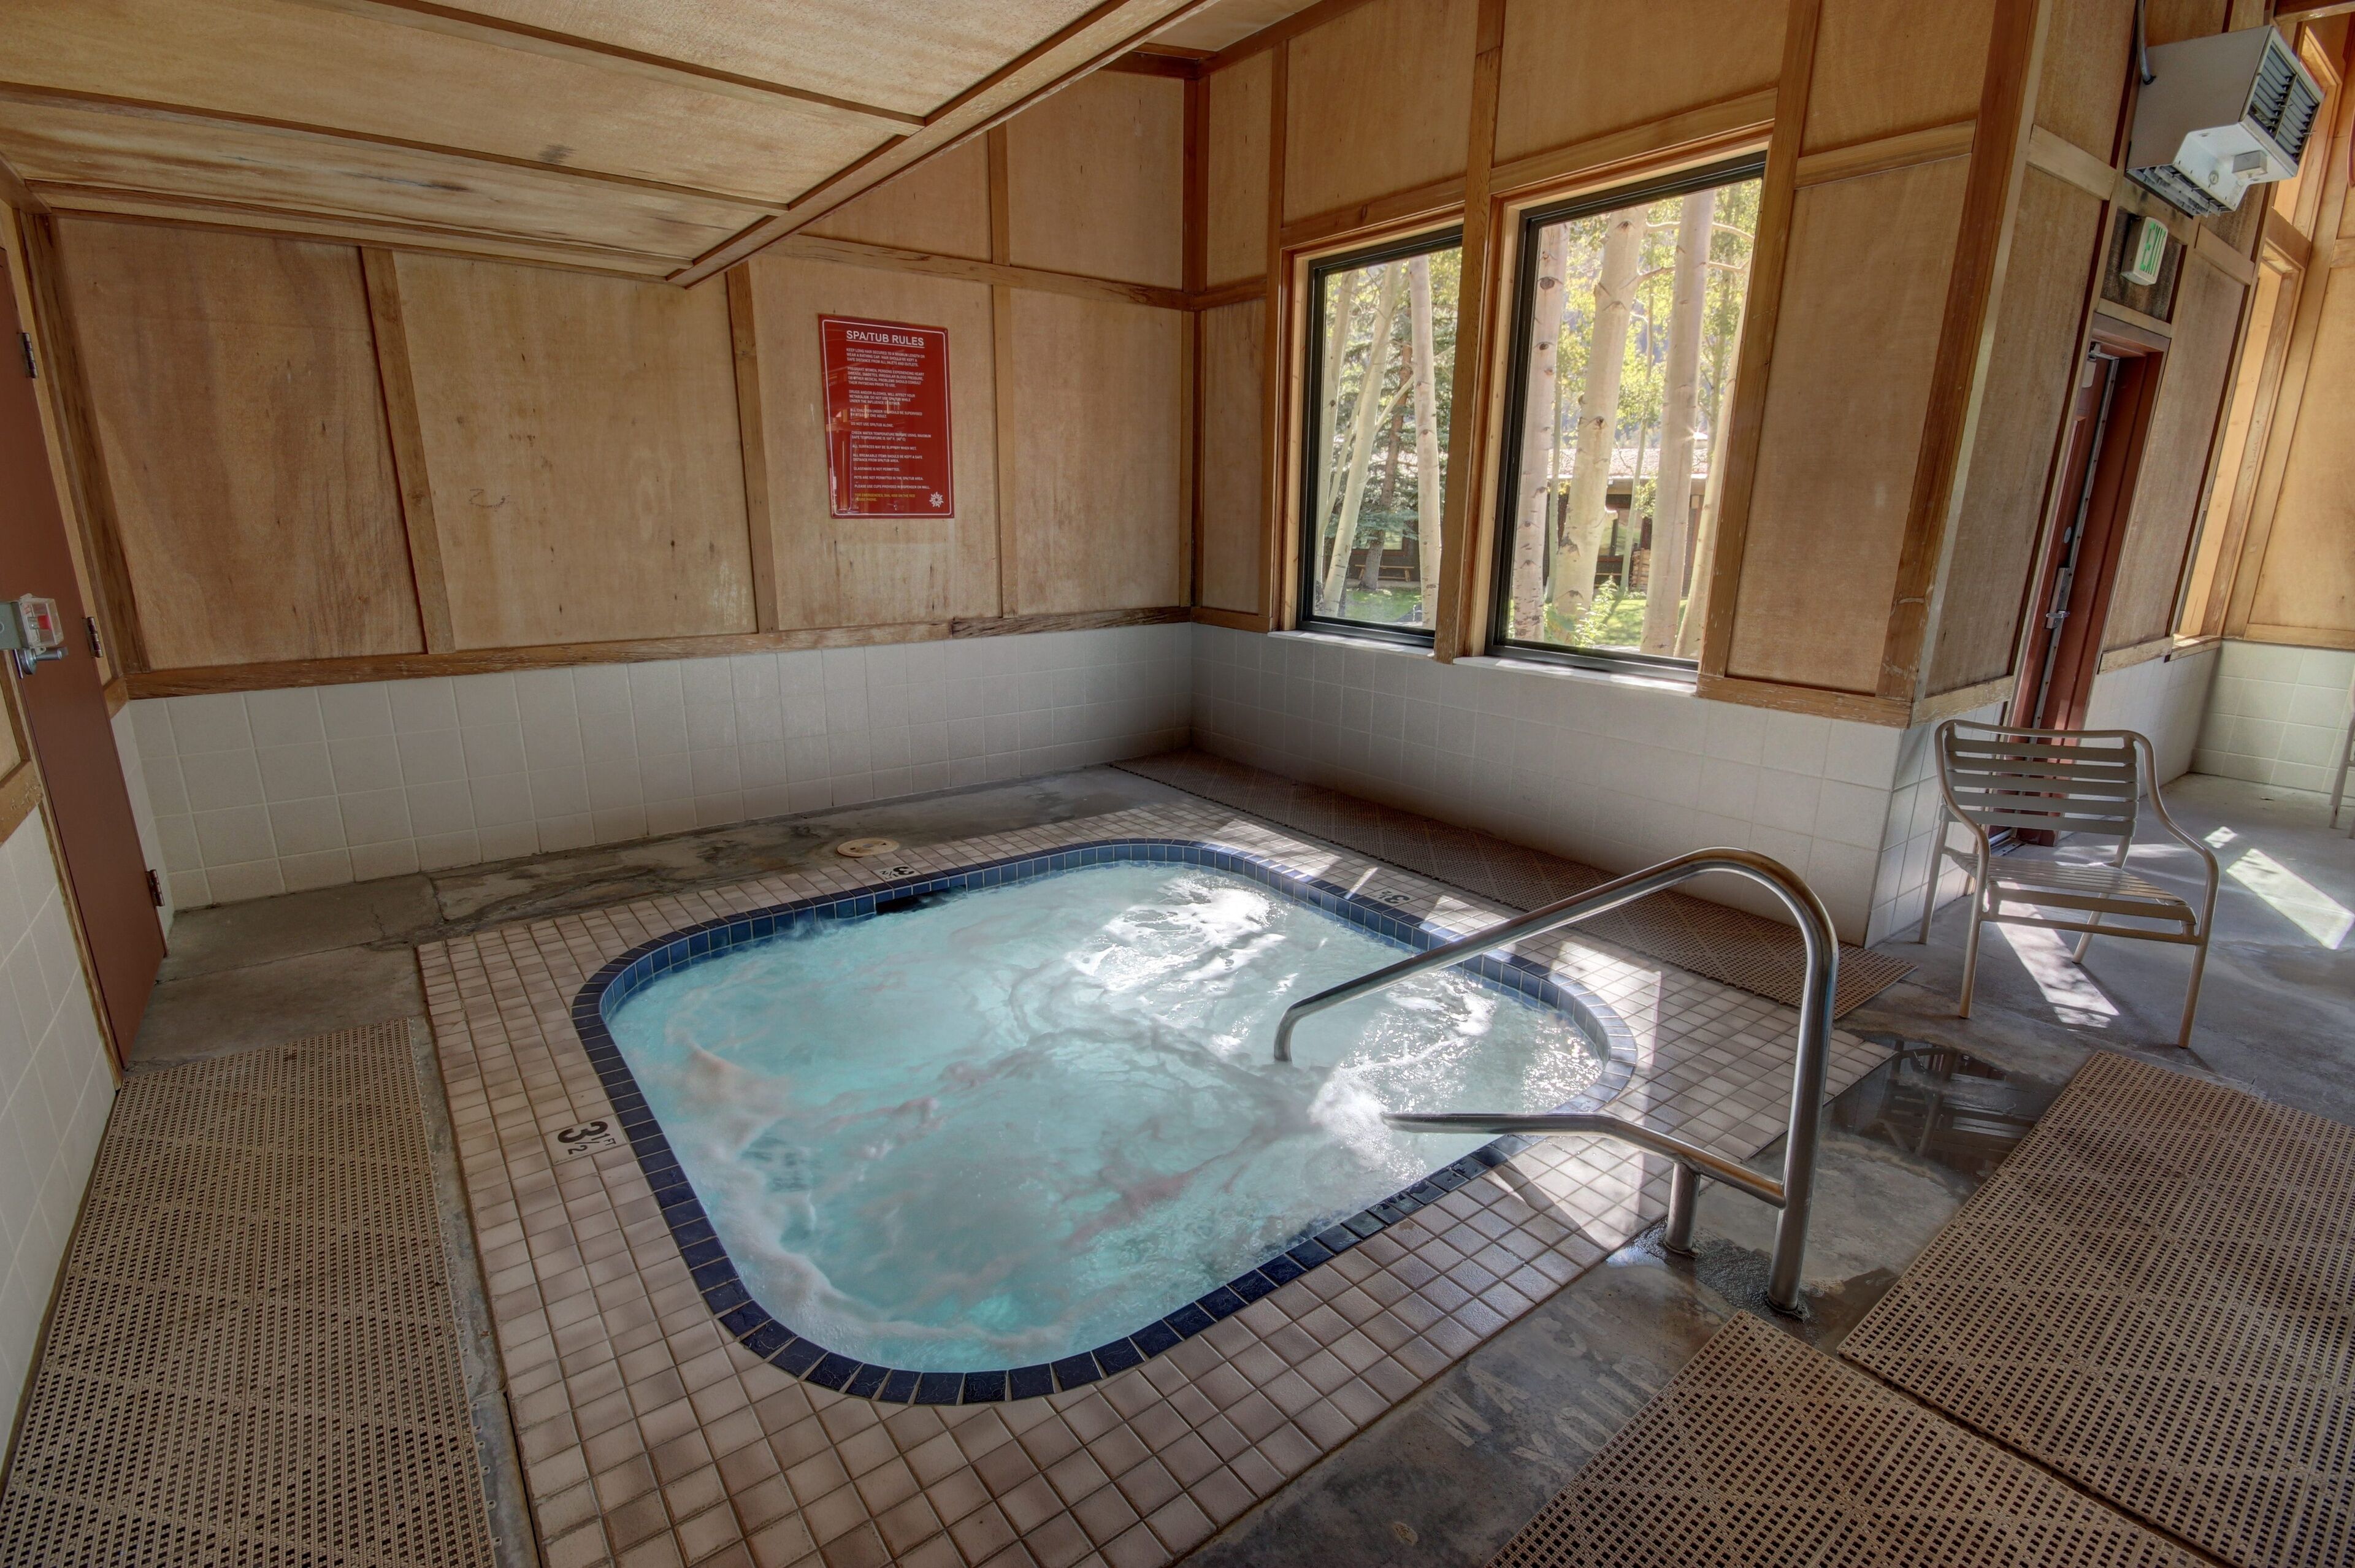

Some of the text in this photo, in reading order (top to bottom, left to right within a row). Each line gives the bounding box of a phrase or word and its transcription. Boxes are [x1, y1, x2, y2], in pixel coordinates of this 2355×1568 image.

[846, 331, 924, 346] SPA/TUB RULES
[603, 1138, 617, 1146] FT
